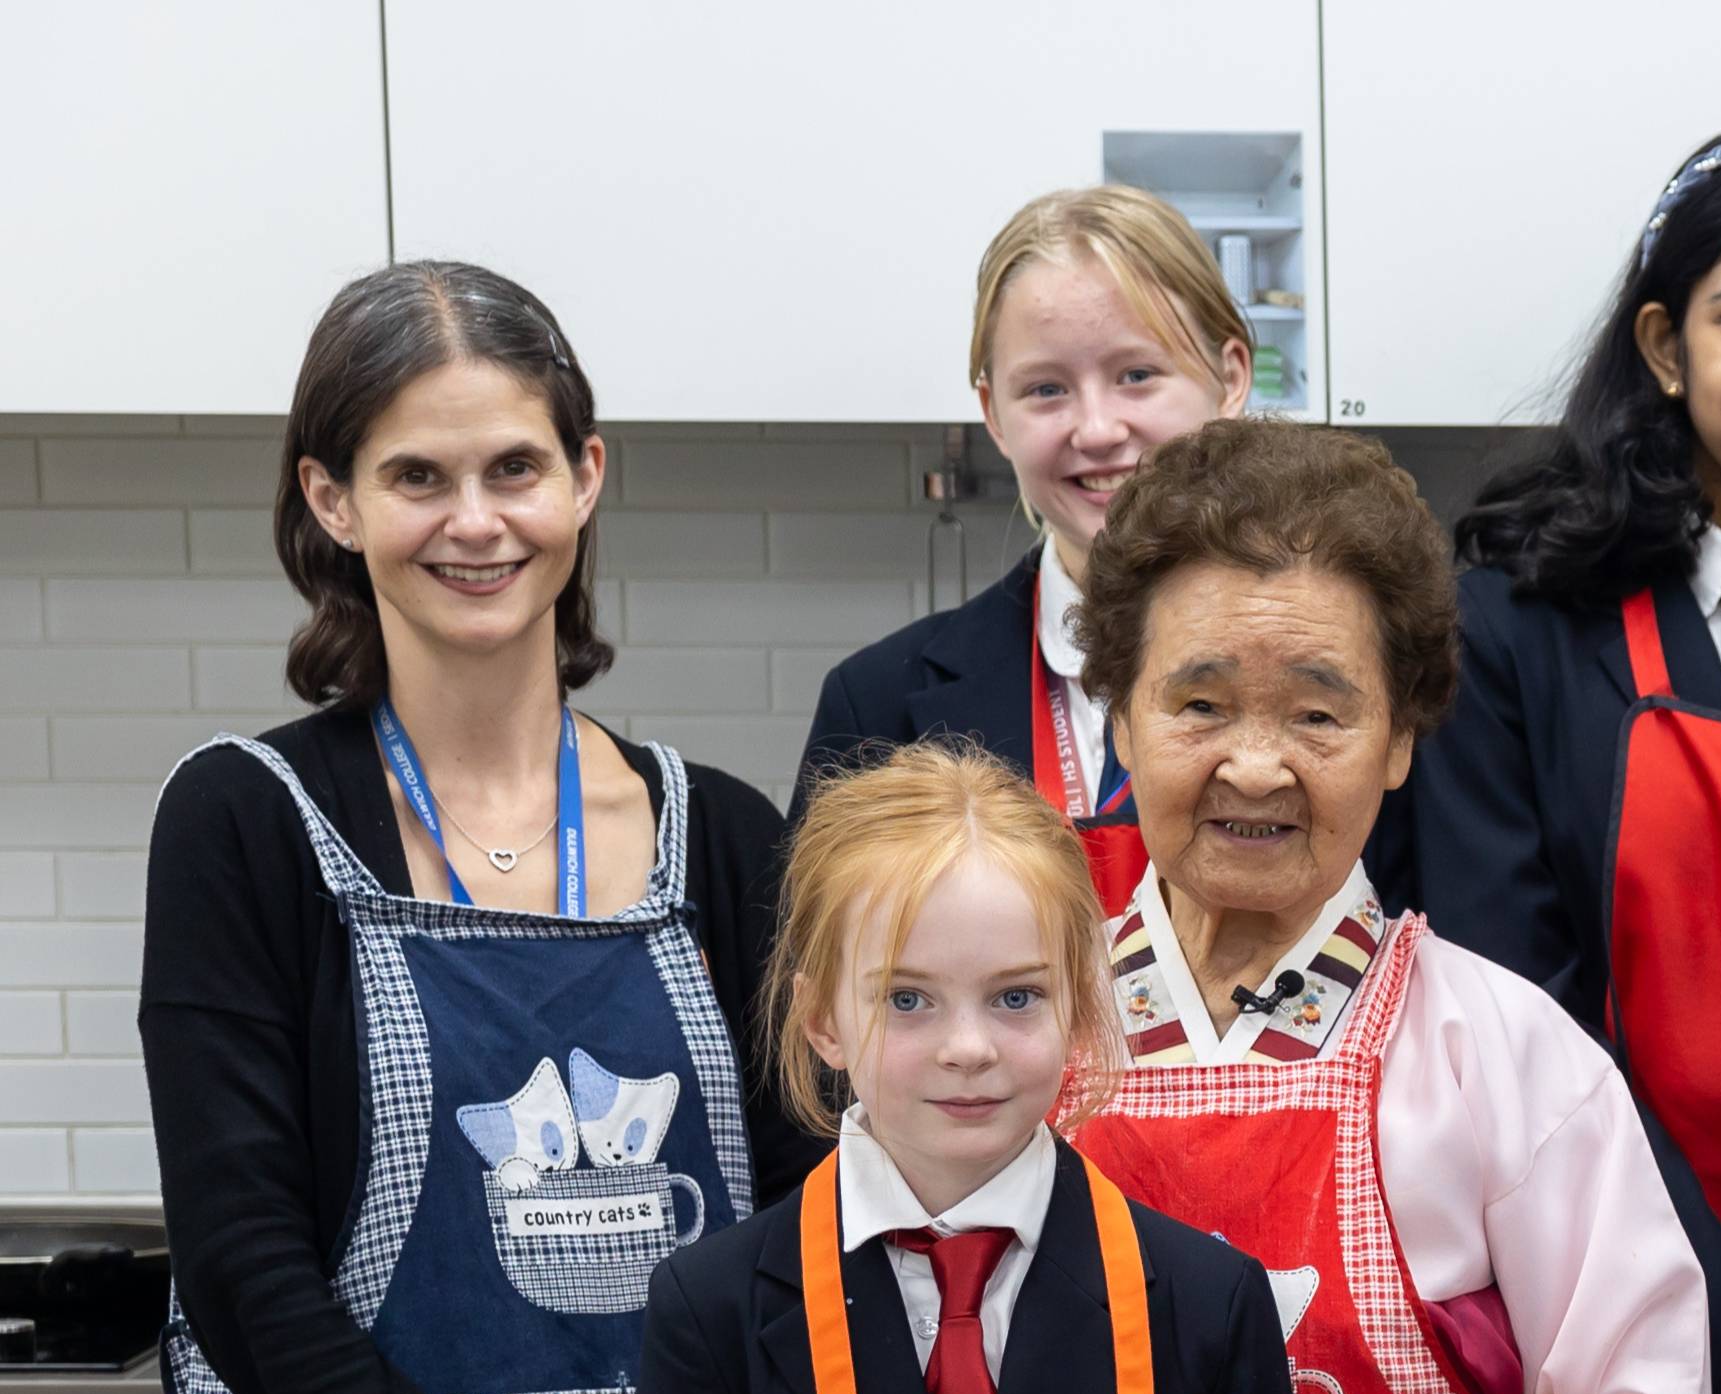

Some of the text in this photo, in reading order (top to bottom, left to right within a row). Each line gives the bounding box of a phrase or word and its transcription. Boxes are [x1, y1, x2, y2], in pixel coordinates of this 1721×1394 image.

[1340, 399, 1366, 417] 20
[1051, 690, 1072, 756] STUDENT
[1063, 761, 1076, 781] HS
[566, 828, 578, 918] DULWICH COLLEGE
[524, 1206, 635, 1227] country cats
